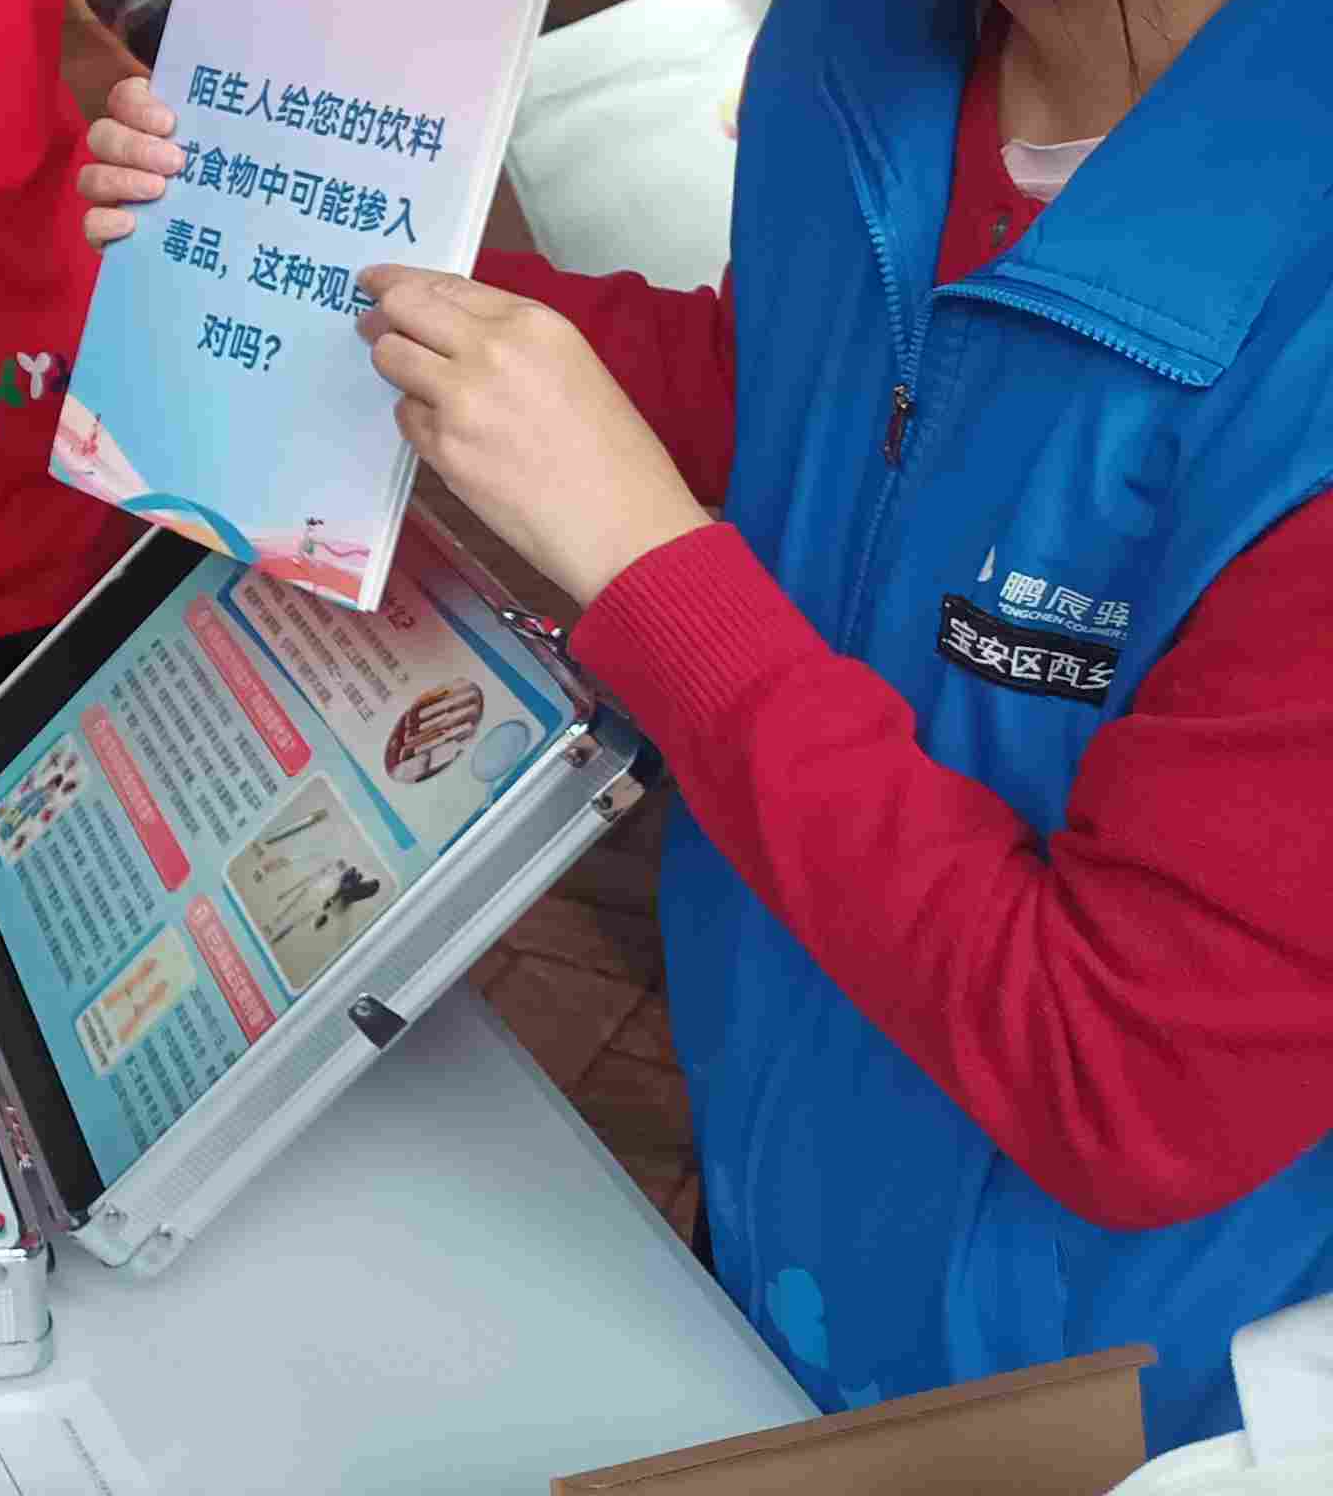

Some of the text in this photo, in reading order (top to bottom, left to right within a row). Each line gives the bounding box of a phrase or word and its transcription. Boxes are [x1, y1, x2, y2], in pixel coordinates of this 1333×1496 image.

[187, 64, 446, 163] 陌生人给您的饮料
[198, 314, 282, 374] 对吗？
[1000, 571, 1130, 627] 鹏辰驿
[942, 617, 1115, 689] 宝安区西乡
